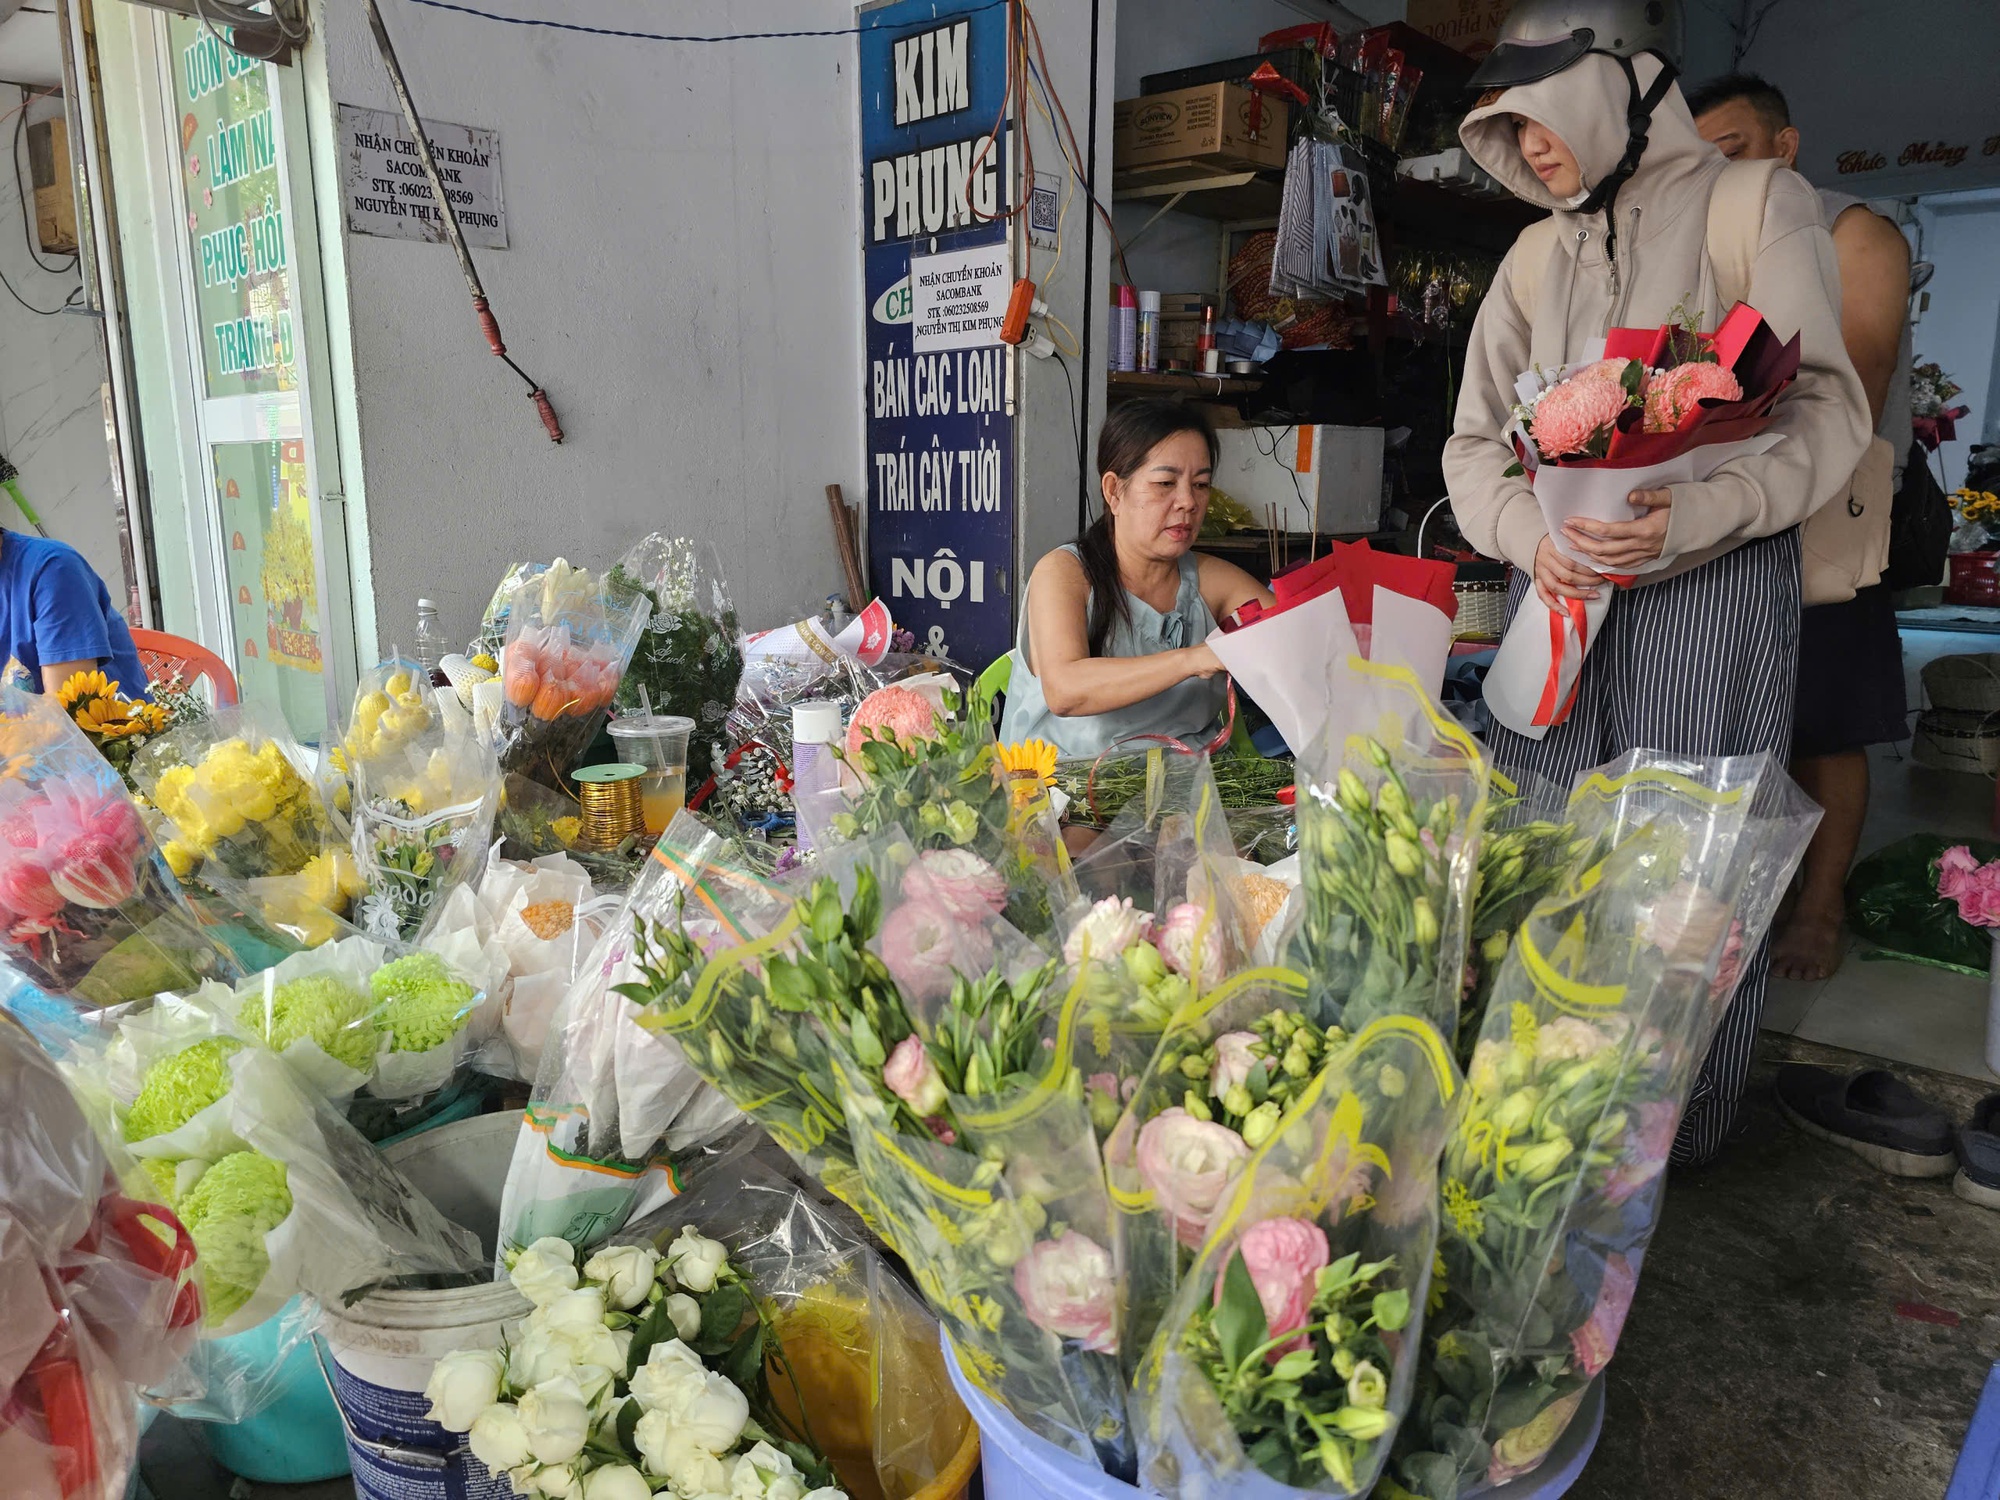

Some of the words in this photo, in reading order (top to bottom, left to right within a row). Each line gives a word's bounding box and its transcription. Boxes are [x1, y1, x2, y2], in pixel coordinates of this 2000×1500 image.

[184, 20, 225, 102] UỐN
[895, 21, 969, 126] KIM
[207, 118, 250, 191] LÀM
[354, 132, 391, 154] NHẬN
[448, 148, 489, 167] KHOẢN
[1836, 148, 1887, 175] Chúc
[372, 178, 396, 195] STK
[386, 159, 462, 184] SACOMANK
[872, 135, 997, 254] PHỤNG
[355, 195, 407, 217] NGUYỄN
[410, 204, 430, 222] THỊ
[459, 210, 498, 231] PHỤNG
[200, 223, 250, 293] PHỤC
[919, 271, 941, 287] NHẬN
[942, 265, 973, 284] CHUYỂN
[974, 262, 1002, 279] KHOẢN
[936, 285, 982, 301] SACOMBANK
[916, 318, 947, 337] NGUYỄN
[948, 321, 962, 335] THỊ
[962, 319, 977, 332] KIM
[978, 316, 1004, 334] PHỤNG
[927, 307, 942, 319] STK
[214, 314, 276, 375] TRANG
[873, 342, 909, 419] BÁN
[957, 349, 1000, 426] LOẠI
[875, 435, 914, 512] TRÁI
[919, 434, 954, 512] CÂY
[958, 436, 1000, 512] TƯƠI
[892, 548, 984, 609] NỘI
[808, 634, 834, 664] FLOWER
[925, 625, 949, 658] &
